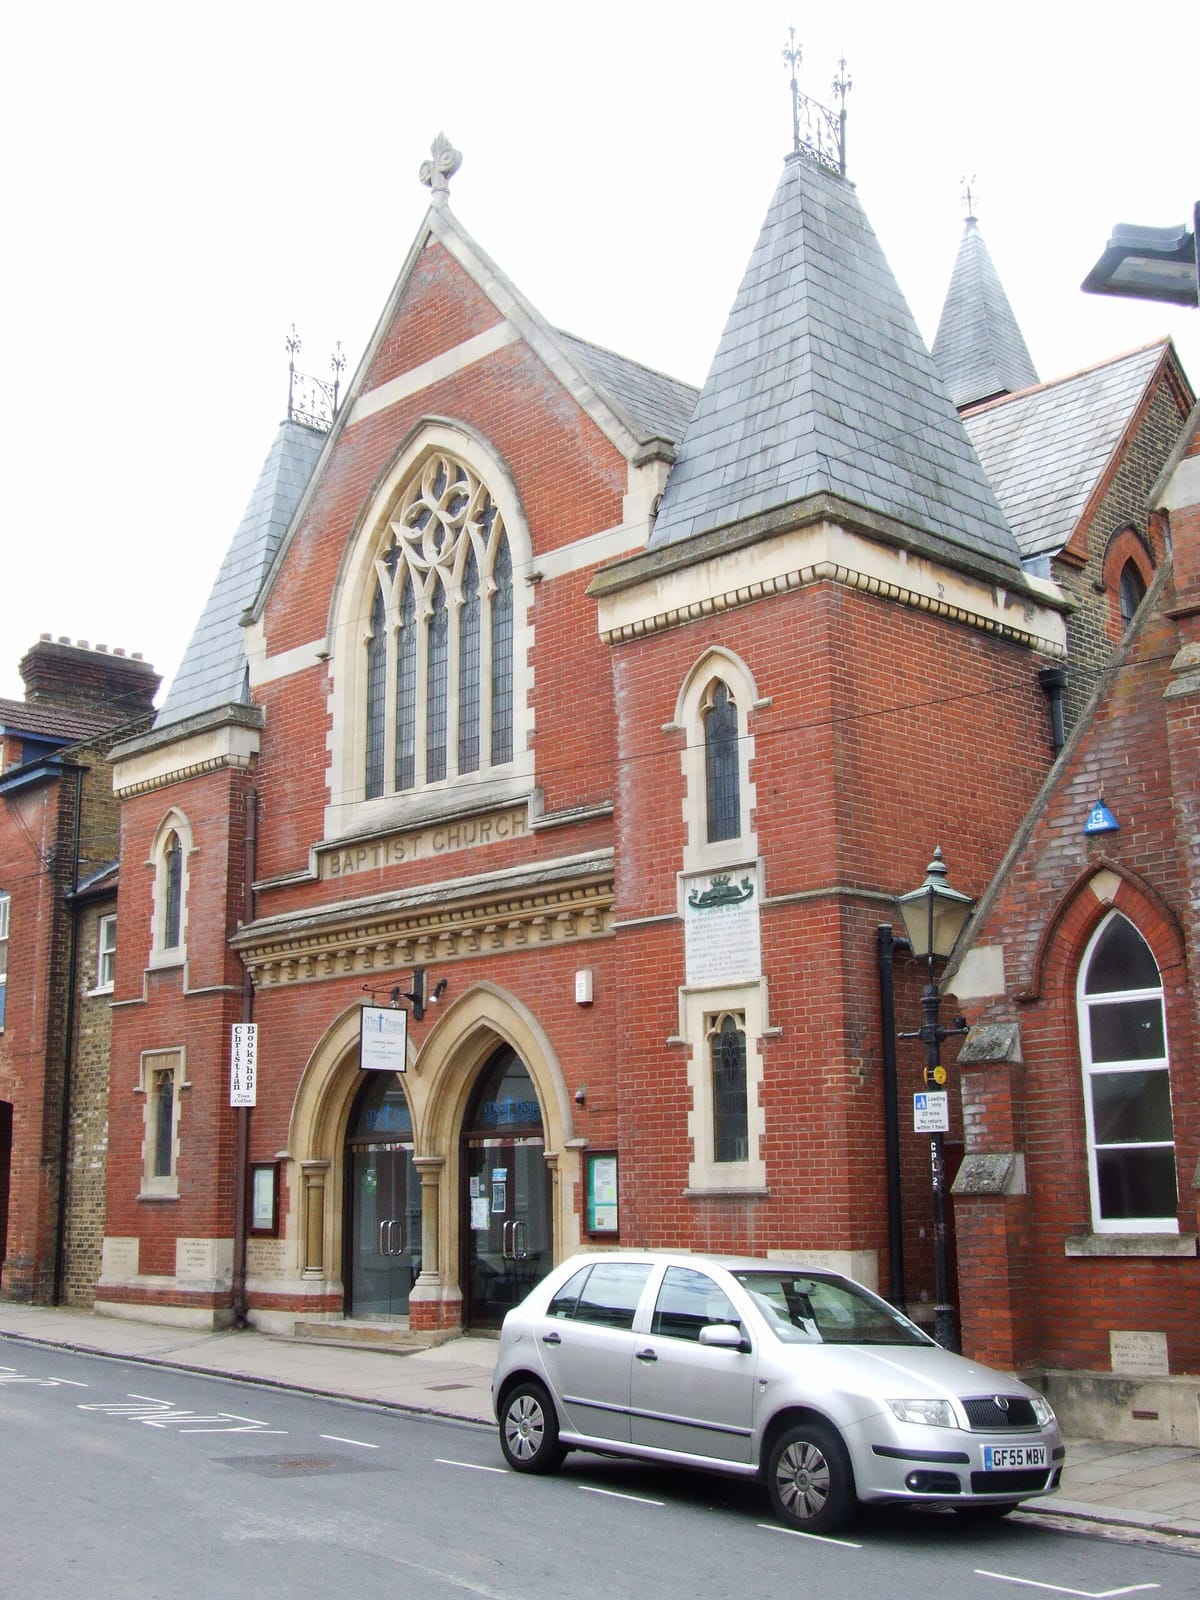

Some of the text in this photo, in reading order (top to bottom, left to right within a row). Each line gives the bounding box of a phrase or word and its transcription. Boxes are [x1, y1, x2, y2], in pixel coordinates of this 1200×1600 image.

[330, 812, 526, 874] BAPTIST CHURCH
[233, 1026, 242, 1090] Christian
[246, 1026, 255, 1090] Bookshop
[933, 1177, 938, 1185] 2
[77, 1403, 289, 1434] ONLY
[993, 1447, 1045, 1466] GF55 MBV
